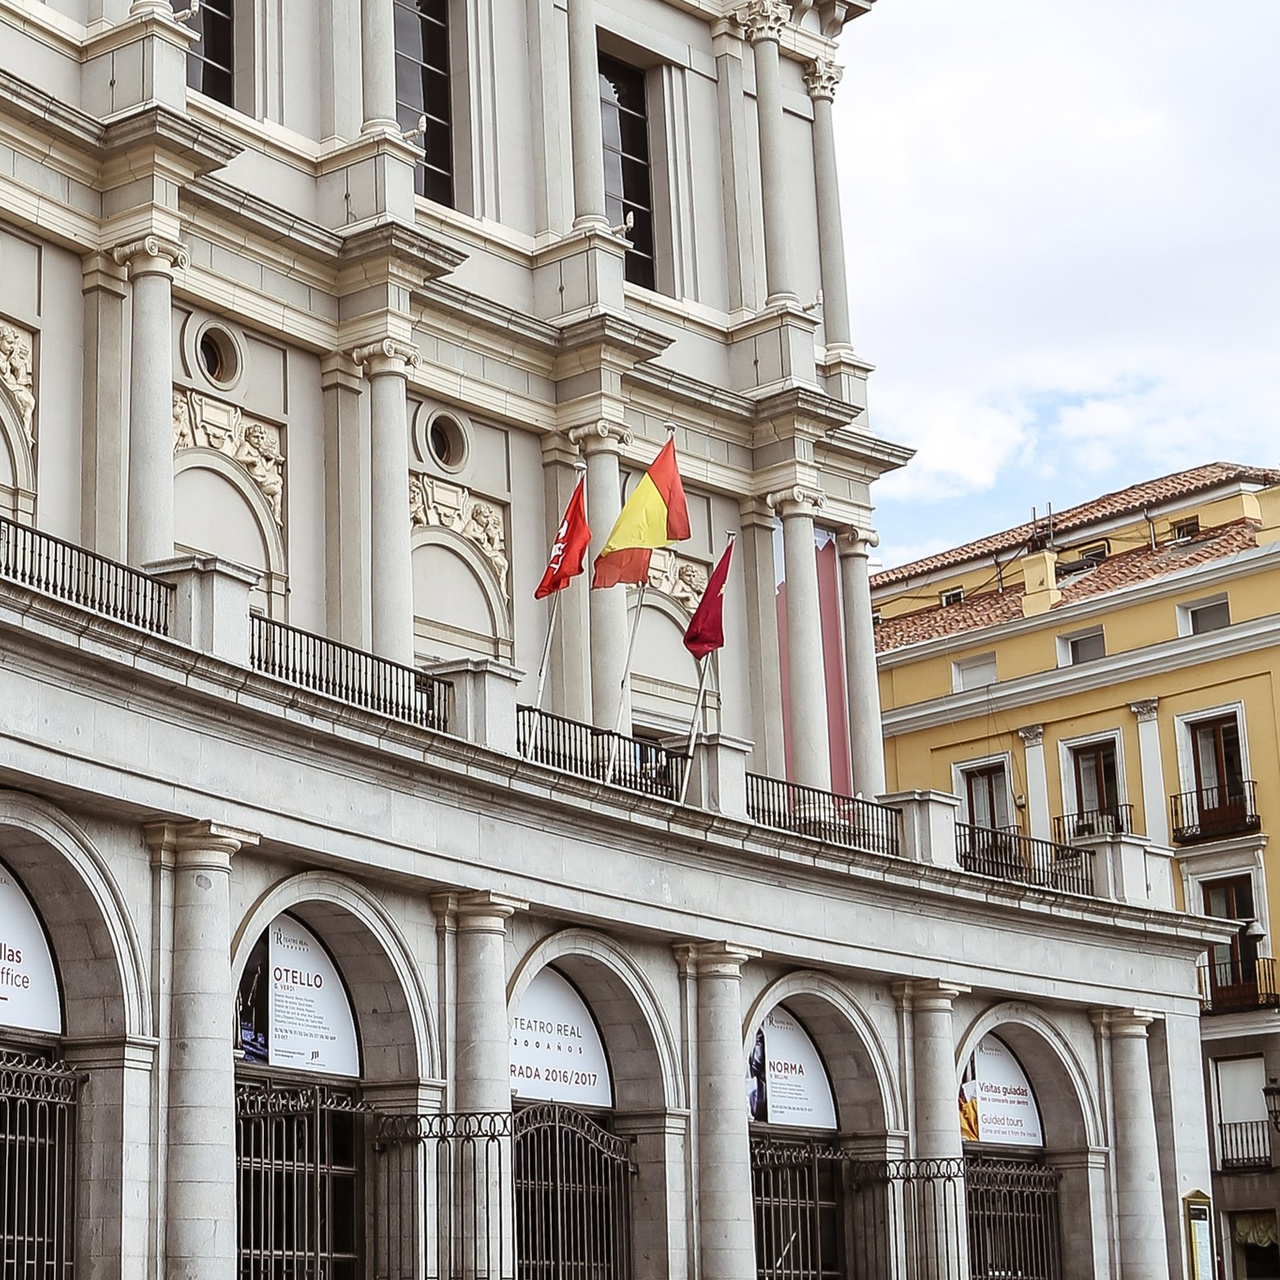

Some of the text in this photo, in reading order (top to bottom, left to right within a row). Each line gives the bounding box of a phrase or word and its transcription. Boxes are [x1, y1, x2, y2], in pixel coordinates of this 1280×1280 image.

[273, 966, 323, 989] OTELLO
[514, 1016, 582, 1038] TEATRO REAL
[513, 1038, 583, 1055] 200 AÑOS
[768, 1060, 805, 1076] NORMA
[544, 1068, 598, 1087] 2016/2017
[979, 1082, 1028, 1097] Visitas guiadas
[981, 1113, 1024, 1128] Guided tours
